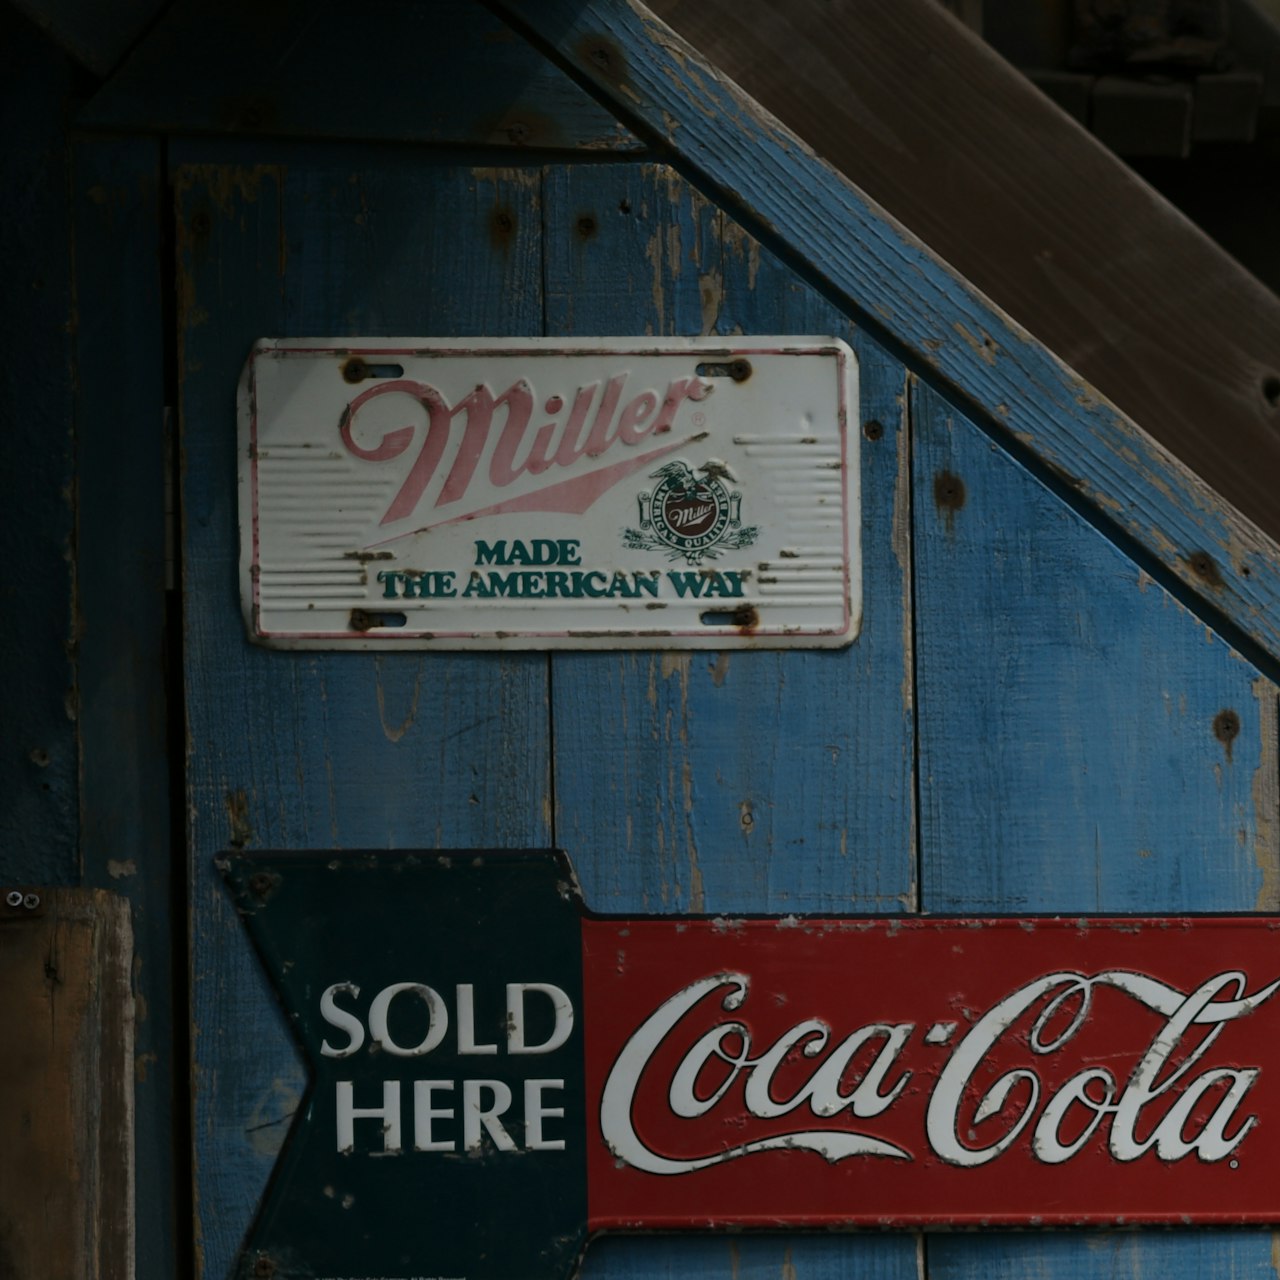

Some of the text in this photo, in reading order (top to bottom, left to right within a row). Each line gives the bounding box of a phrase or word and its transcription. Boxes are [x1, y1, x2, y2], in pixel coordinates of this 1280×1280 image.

[339, 374, 715, 526] Miller
[668, 503, 715, 527] Miller
[684, 514, 727, 548] QUALITY
[475, 539, 580, 567] MADE
[377, 570, 749, 599] THE AMERICAN WAY
[319, 980, 575, 1060] SOLD
[335, 1077, 567, 1157] HERE
